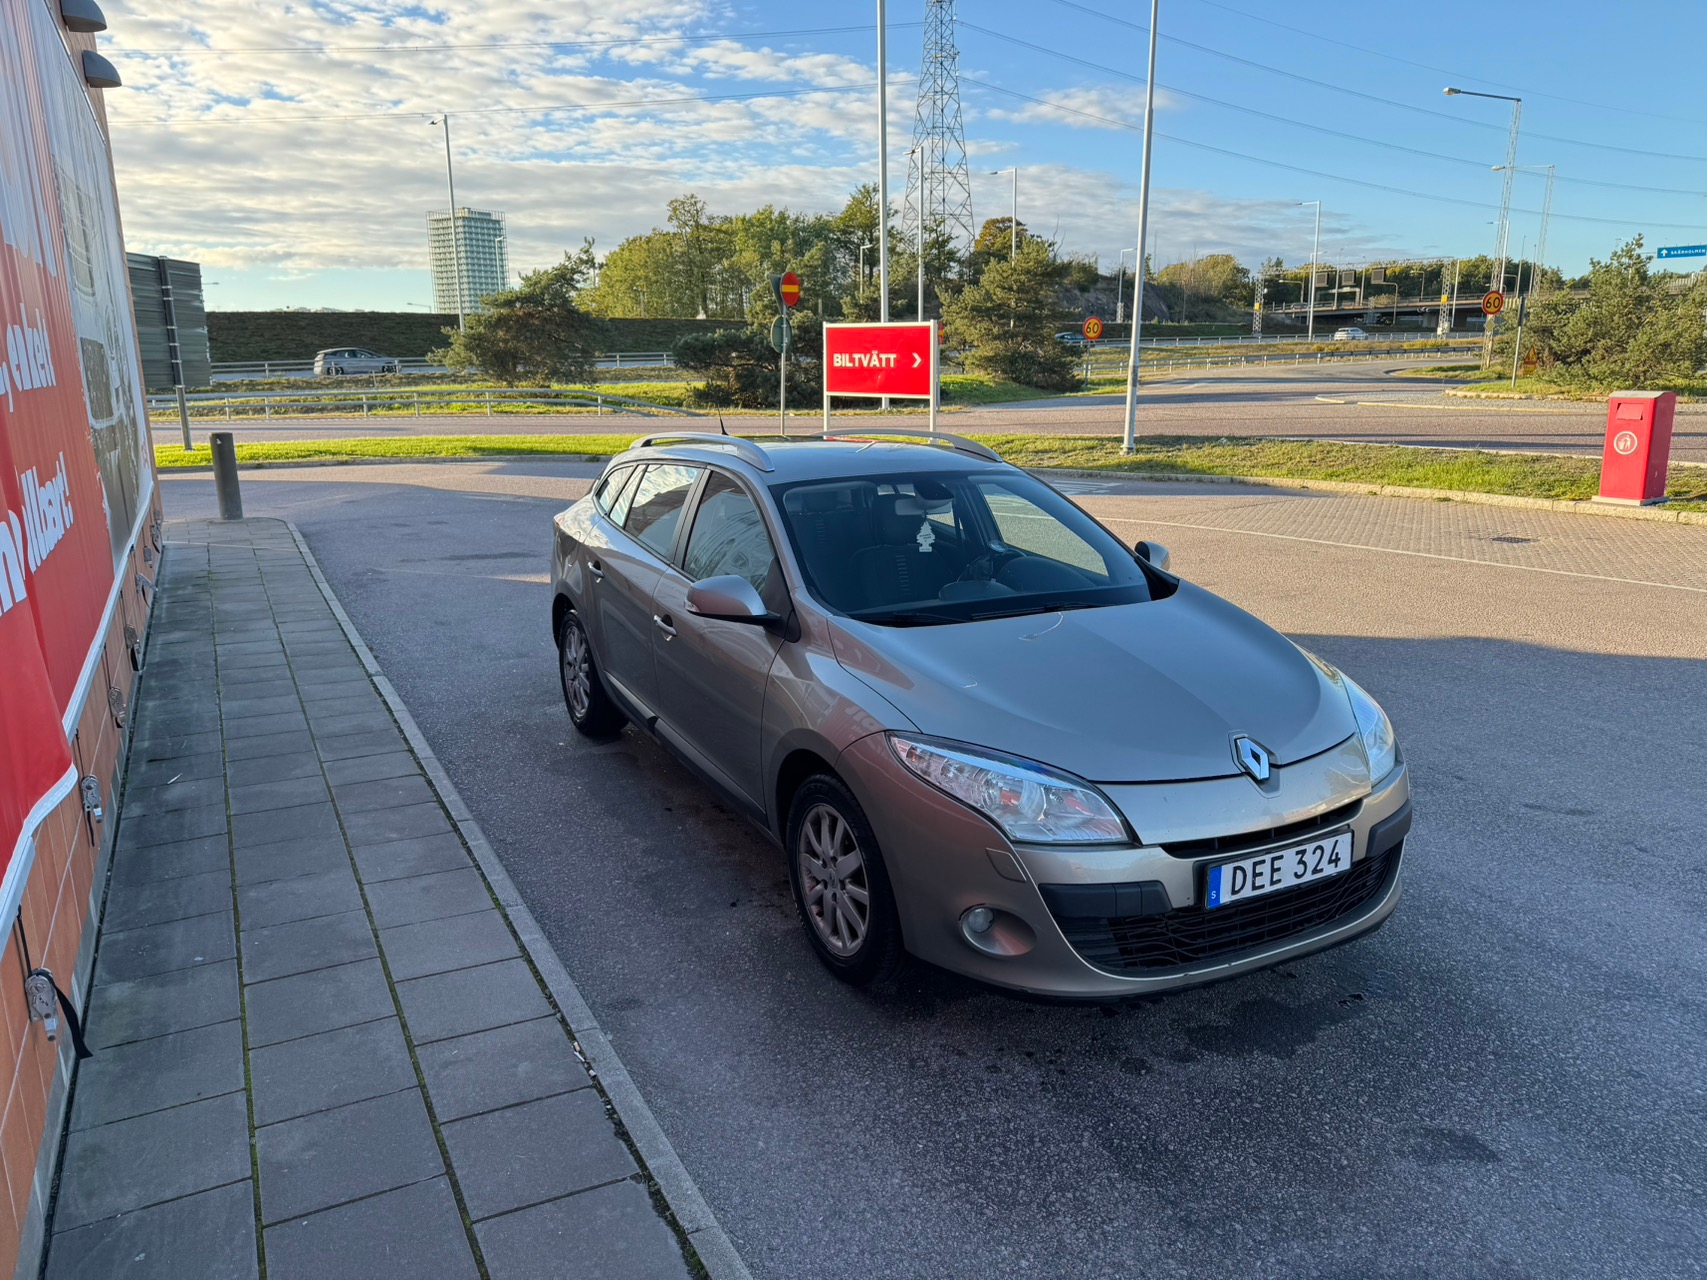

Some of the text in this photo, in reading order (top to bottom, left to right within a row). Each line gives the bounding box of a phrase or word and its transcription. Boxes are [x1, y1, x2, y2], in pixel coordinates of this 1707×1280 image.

[1486, 297, 1500, 309] 60
[1086, 322, 1099, 334] 60
[7, 303, 56, 392] enkelt
[833, 350, 897, 368] BILTVÄTT
[1231, 839, 1341, 896] DEE 324
[1211, 890, 1217, 899] S
